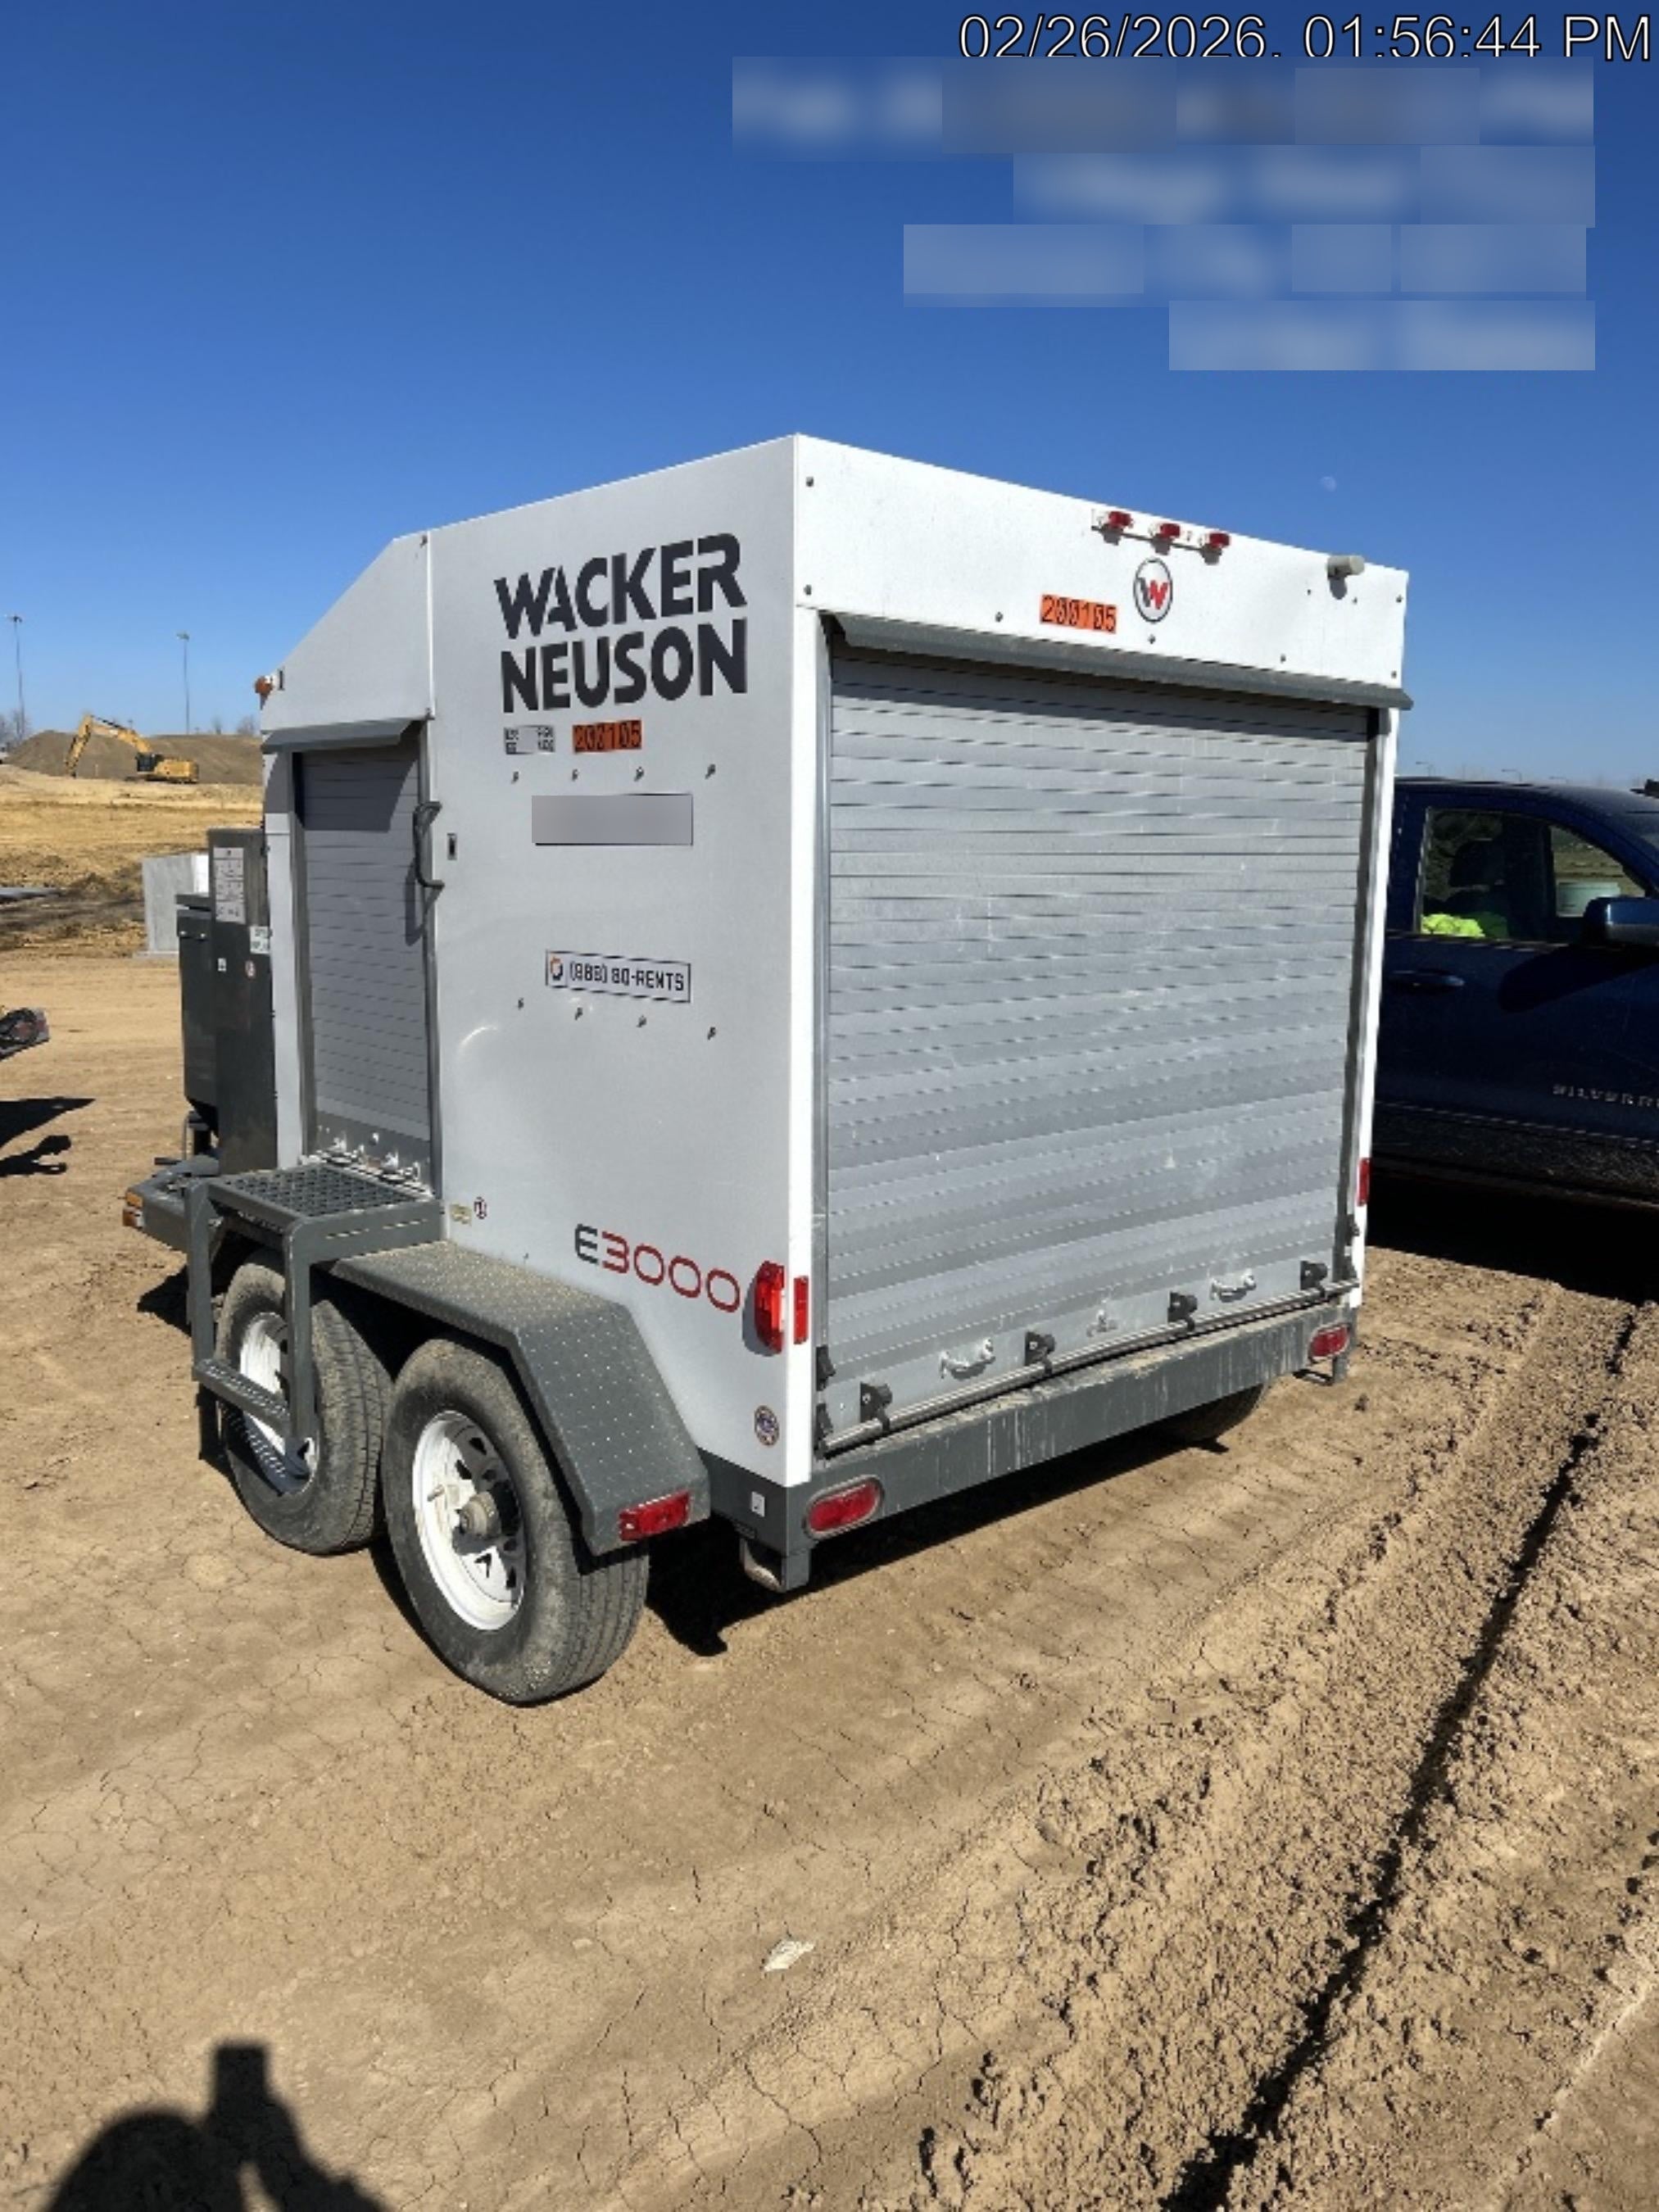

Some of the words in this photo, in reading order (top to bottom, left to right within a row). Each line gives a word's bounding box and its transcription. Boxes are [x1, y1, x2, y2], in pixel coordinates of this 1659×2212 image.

[493, 533, 748, 639] WACKER
[501, 616, 748, 713] NEUSON
[574, 1224, 741, 1312] E3000
